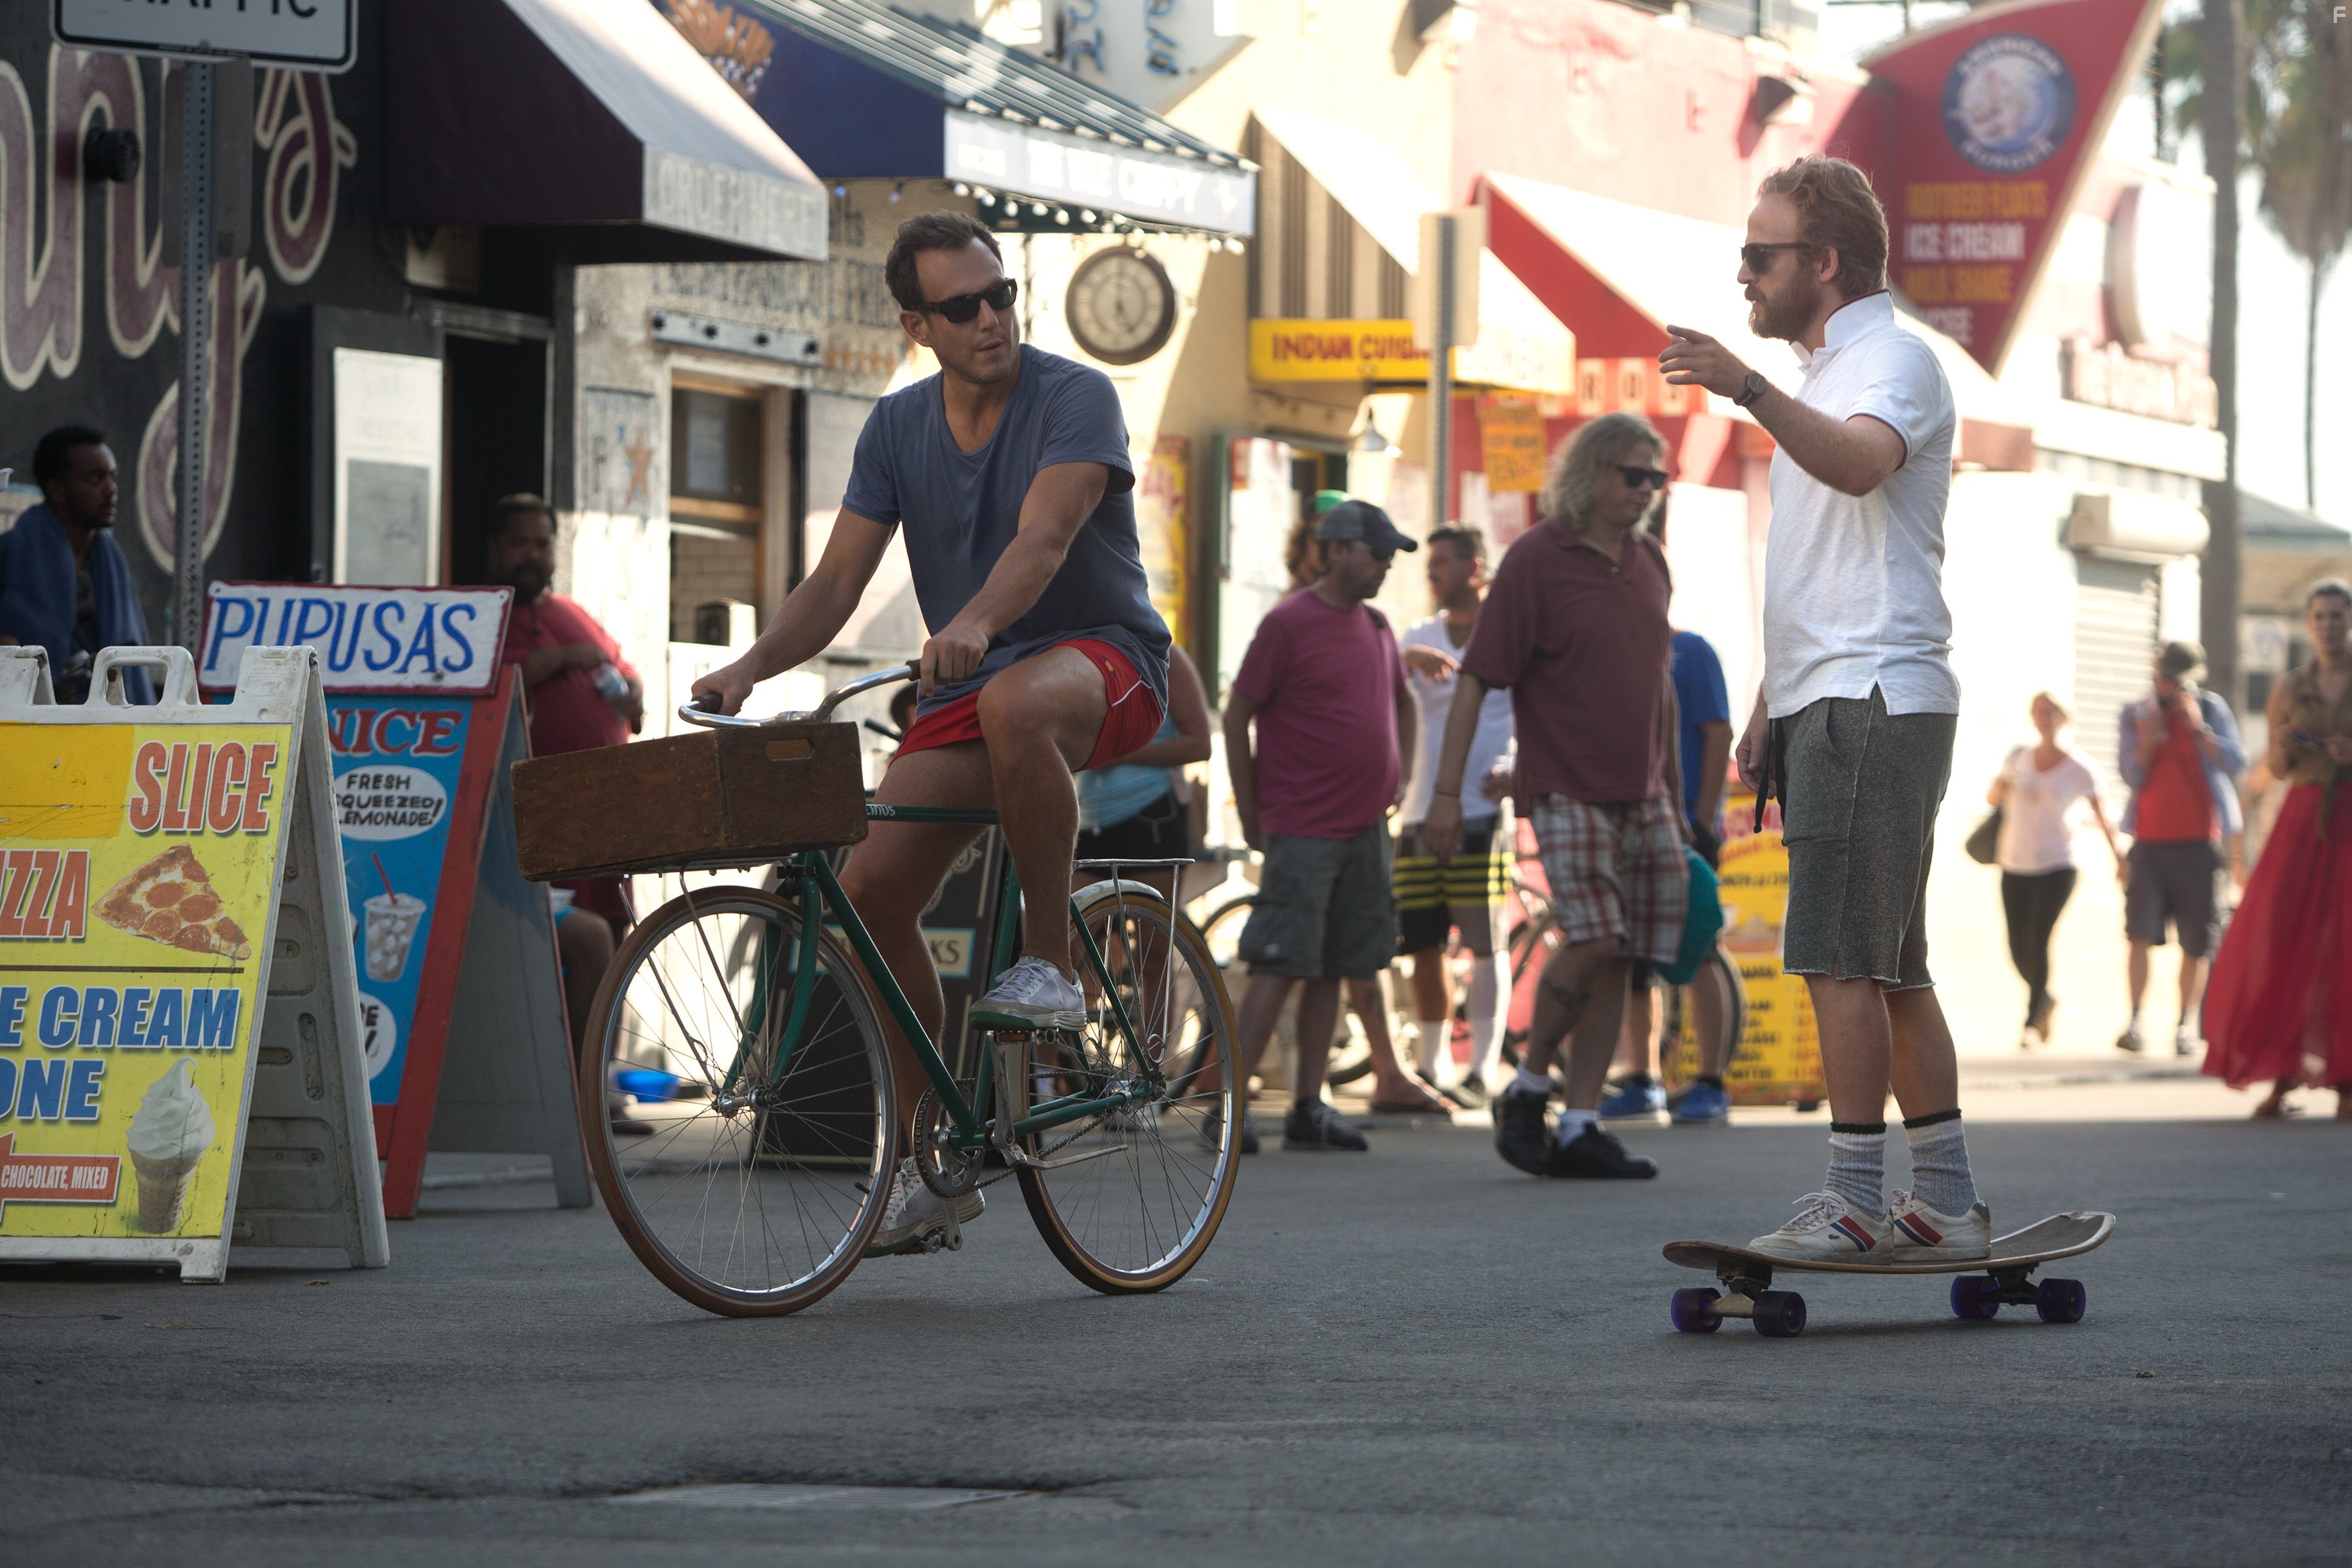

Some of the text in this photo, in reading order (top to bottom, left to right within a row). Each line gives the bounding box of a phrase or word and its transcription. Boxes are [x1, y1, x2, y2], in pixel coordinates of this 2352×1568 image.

[203, 596, 477, 674] PUPUSAS
[128, 740, 278, 834] SLICE
[346, 773, 411, 791] FRESH
[0, 849, 90, 938] ZZA
[38, 985, 242, 1049] CREAM
[1, 1164, 109, 1191] CHOCOLATE, MIXED
